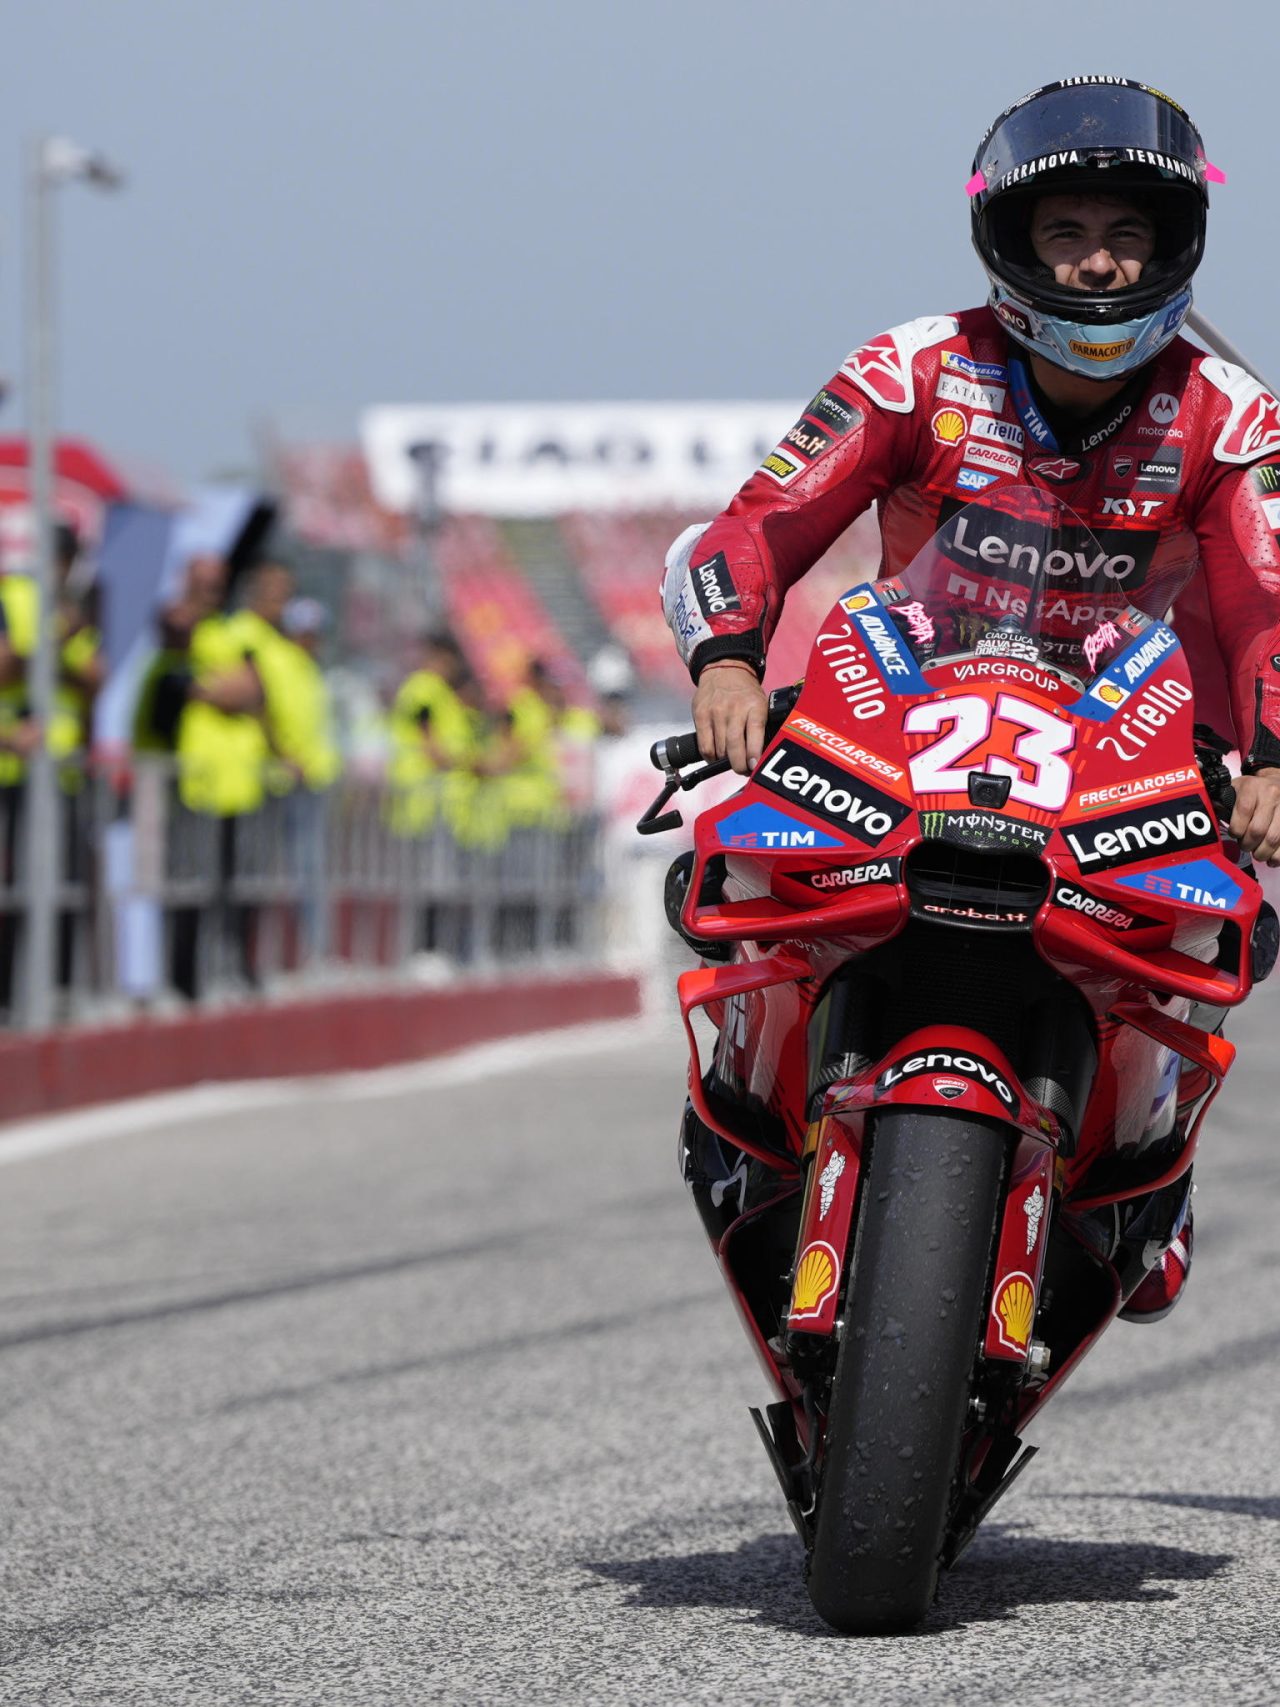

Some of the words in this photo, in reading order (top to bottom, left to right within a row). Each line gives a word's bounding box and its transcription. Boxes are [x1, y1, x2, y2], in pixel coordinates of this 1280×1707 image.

[1059, 75, 1128, 87] TERRANOVA
[1000, 150, 1079, 190] TERRANOVA
[1126, 148, 1197, 184] TERRANOVA
[1072, 340, 1133, 358] PARMACOTTO
[959, 362, 1003, 376] MICHELIN
[941, 381, 998, 403] EATALY
[987, 420, 1024, 444] riello
[1024, 407, 1048, 442] TIM
[1081, 405, 1132, 452] Lenovo
[1138, 426, 1184, 438] motorola
[967, 446, 1019, 468] CARRERA
[1140, 462, 1177, 474] Lenovo
[957, 471, 989, 488] SAP
[1102, 497, 1164, 517] KYT
[953, 516, 1136, 580] Lenovo
[698, 559, 726, 613] Lenovo
[856, 613, 910, 676] ADVANCE
[985, 632, 1008, 640] CIAO
[1009, 634, 1033, 645] LUCA
[1009, 642, 1039, 662] 23
[1123, 626, 1176, 685] ADVANCE
[822, 643, 886, 720] riello
[953, 663, 1059, 692] VARGROUP
[1119, 679, 1193, 748] riello
[790, 717, 904, 782] FRECCIAROSSA
[902, 692, 1076, 814] 23
[760, 748, 893, 836] Lenovo
[1079, 768, 1198, 807] FRECCIAROSSA
[762, 830, 815, 847] TIM
[947, 812, 1047, 845] MONSTER
[962, 829, 1031, 848] ENERGY
[1066, 810, 1211, 864] Lenovo
[810, 862, 892, 889] CARRERA
[1056, 887, 1135, 930] CARRERA
[1176, 882, 1226, 909] TIM
[923, 904, 1028, 923] aruba.it
[884, 1053, 1013, 1104] Lenovo
